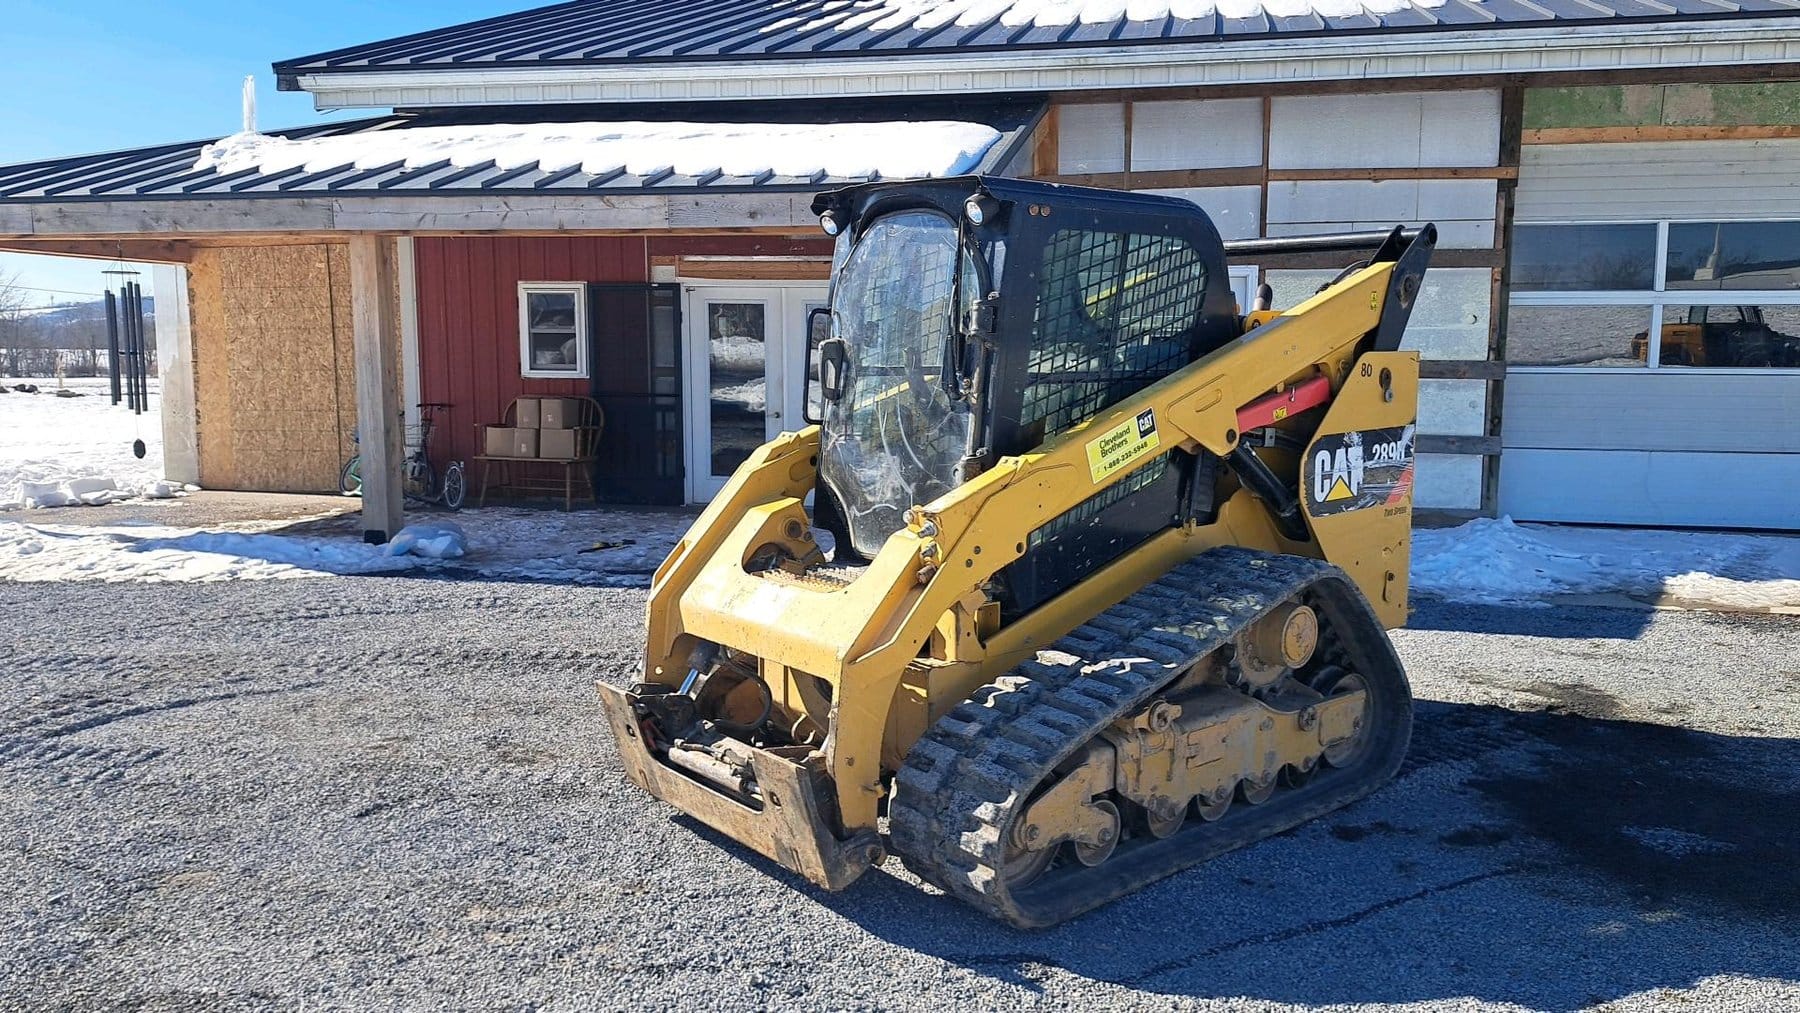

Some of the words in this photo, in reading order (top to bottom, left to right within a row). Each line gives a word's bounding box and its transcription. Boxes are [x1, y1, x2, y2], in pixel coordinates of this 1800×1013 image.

[1360, 362, 1372, 377] 80
[1138, 413, 1153, 432] CAT
[1099, 425, 1131, 450] Cleveland
[1100, 437, 1129, 458] Brothers
[1314, 446, 1364, 503] CAT
